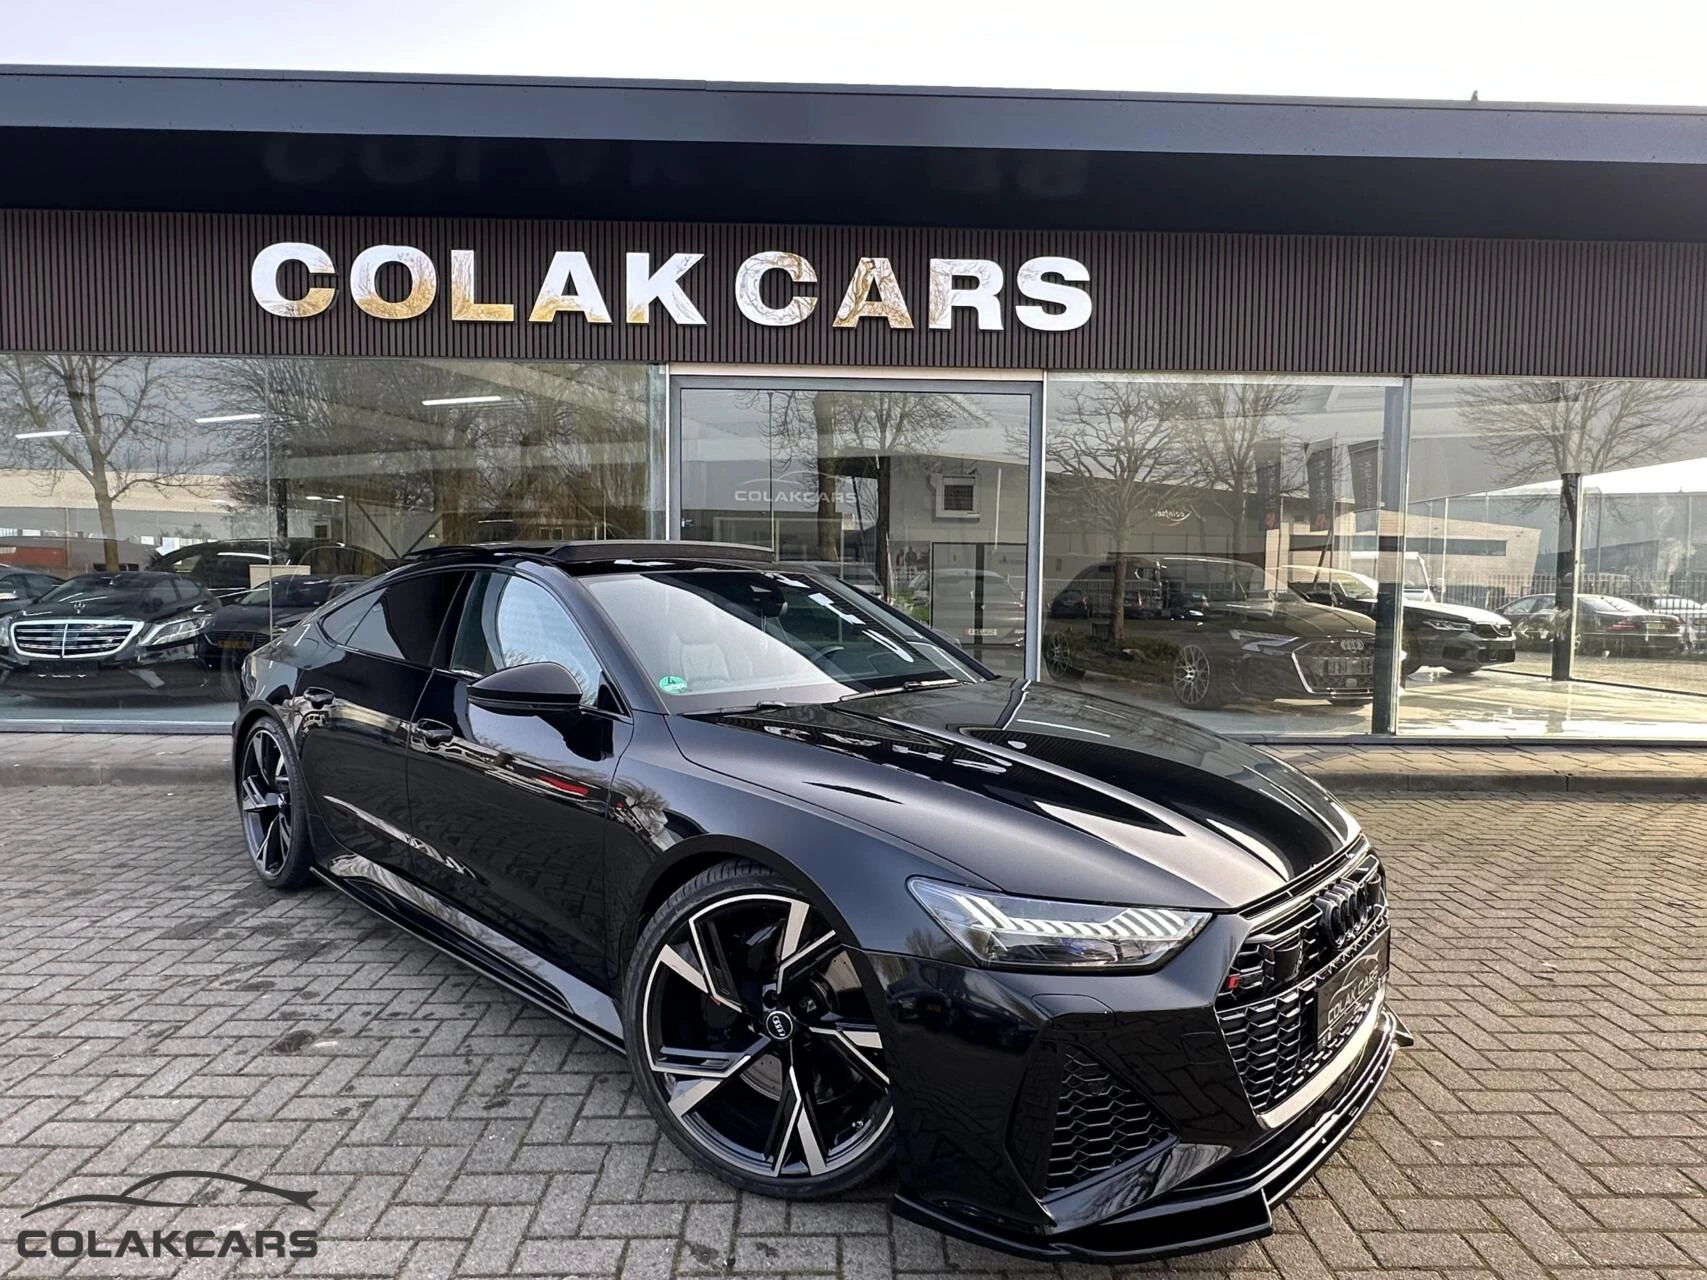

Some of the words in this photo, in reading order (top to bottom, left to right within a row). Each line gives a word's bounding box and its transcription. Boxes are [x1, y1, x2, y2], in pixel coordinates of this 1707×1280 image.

[251, 241, 706, 326] COLAK
[734, 251, 1093, 332] CARS
[734, 490, 857, 503] COLAKCARS
[1327, 986, 1357, 1025] COLAK
[1357, 964, 1379, 993] CARS
